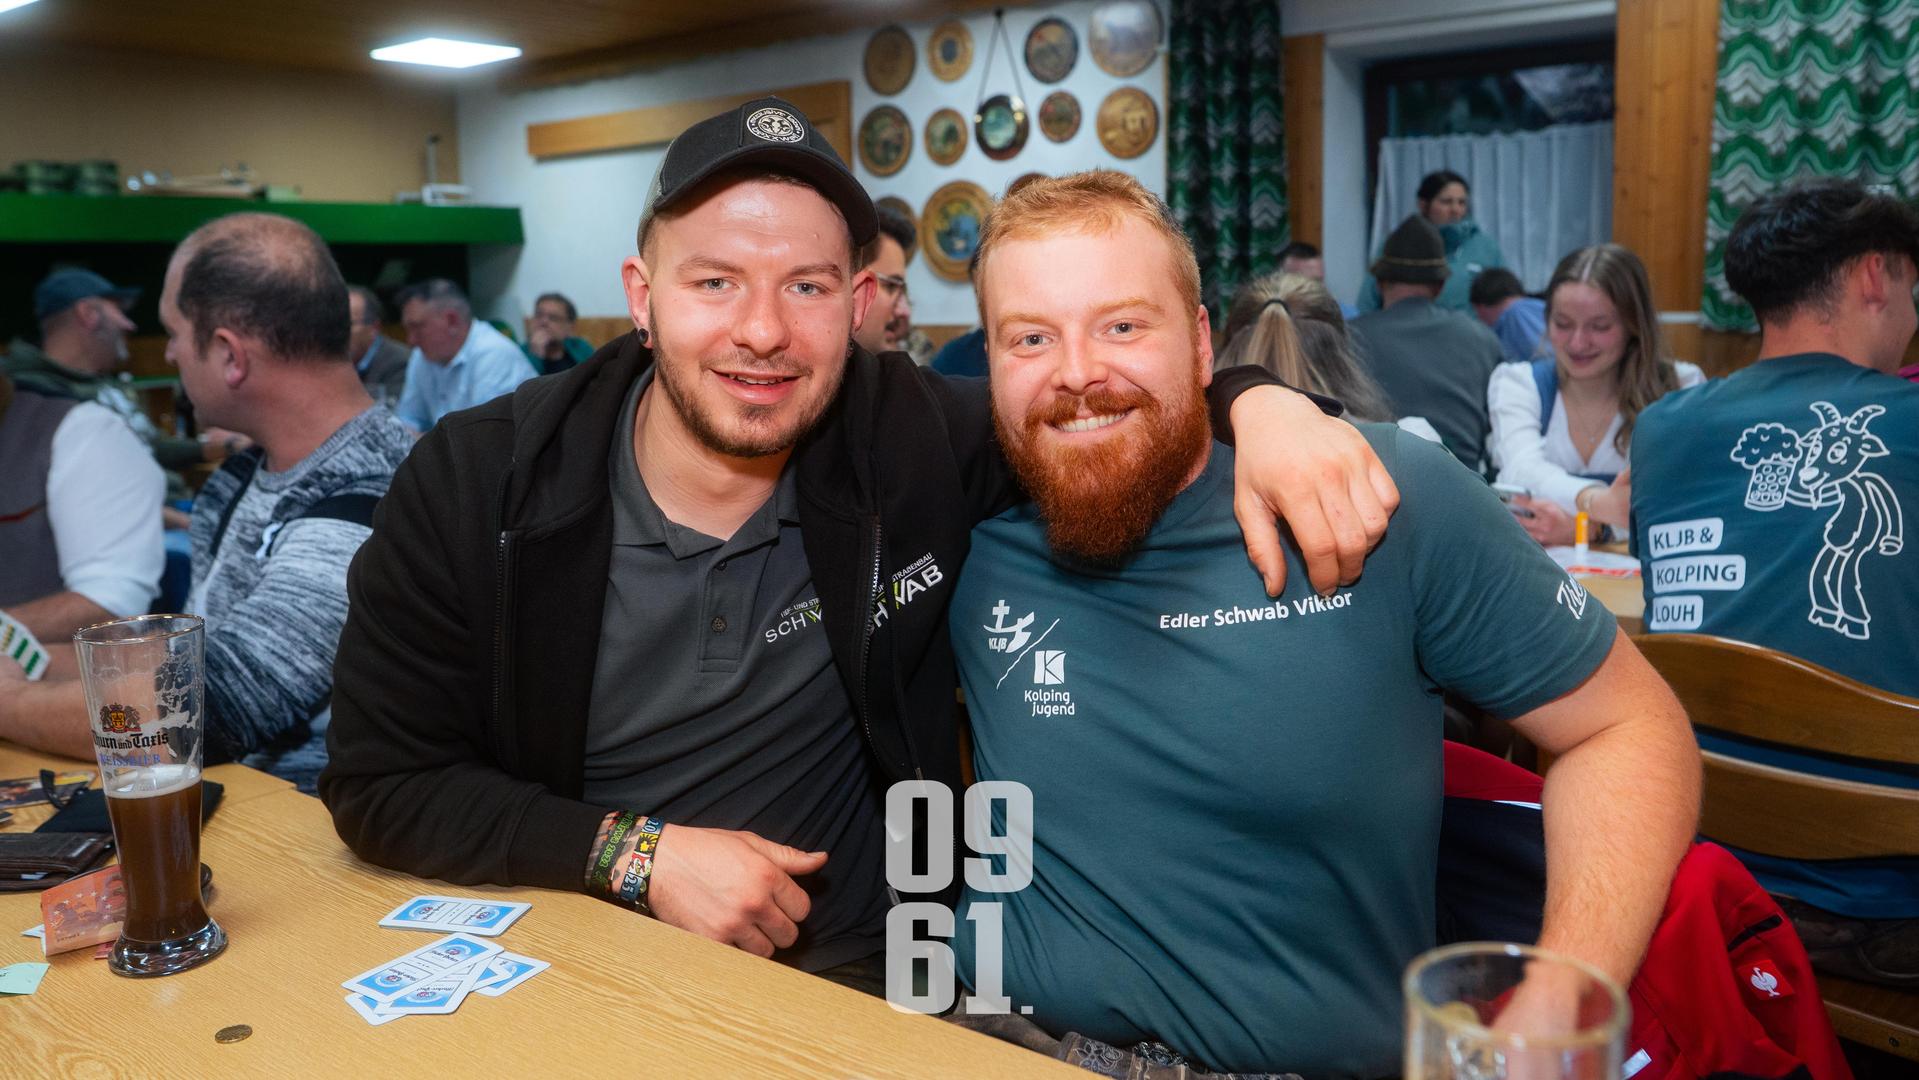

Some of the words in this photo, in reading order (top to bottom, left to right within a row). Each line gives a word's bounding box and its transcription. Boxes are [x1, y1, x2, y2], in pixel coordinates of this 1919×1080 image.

[1654, 528, 1695, 551] KLJB
[1700, 526, 1714, 544] &
[1656, 564, 1738, 587] KOLPING
[1159, 613, 1210, 629] Edler
[1213, 601, 1290, 627] Schwab
[1292, 591, 1354, 616] Viktor
[1656, 604, 1696, 623] LOUH
[988, 637, 1008, 653] KLJB
[1023, 688, 1071, 705] Kolping
[117, 739, 133, 750] und
[599, 843, 617, 869] 2022
